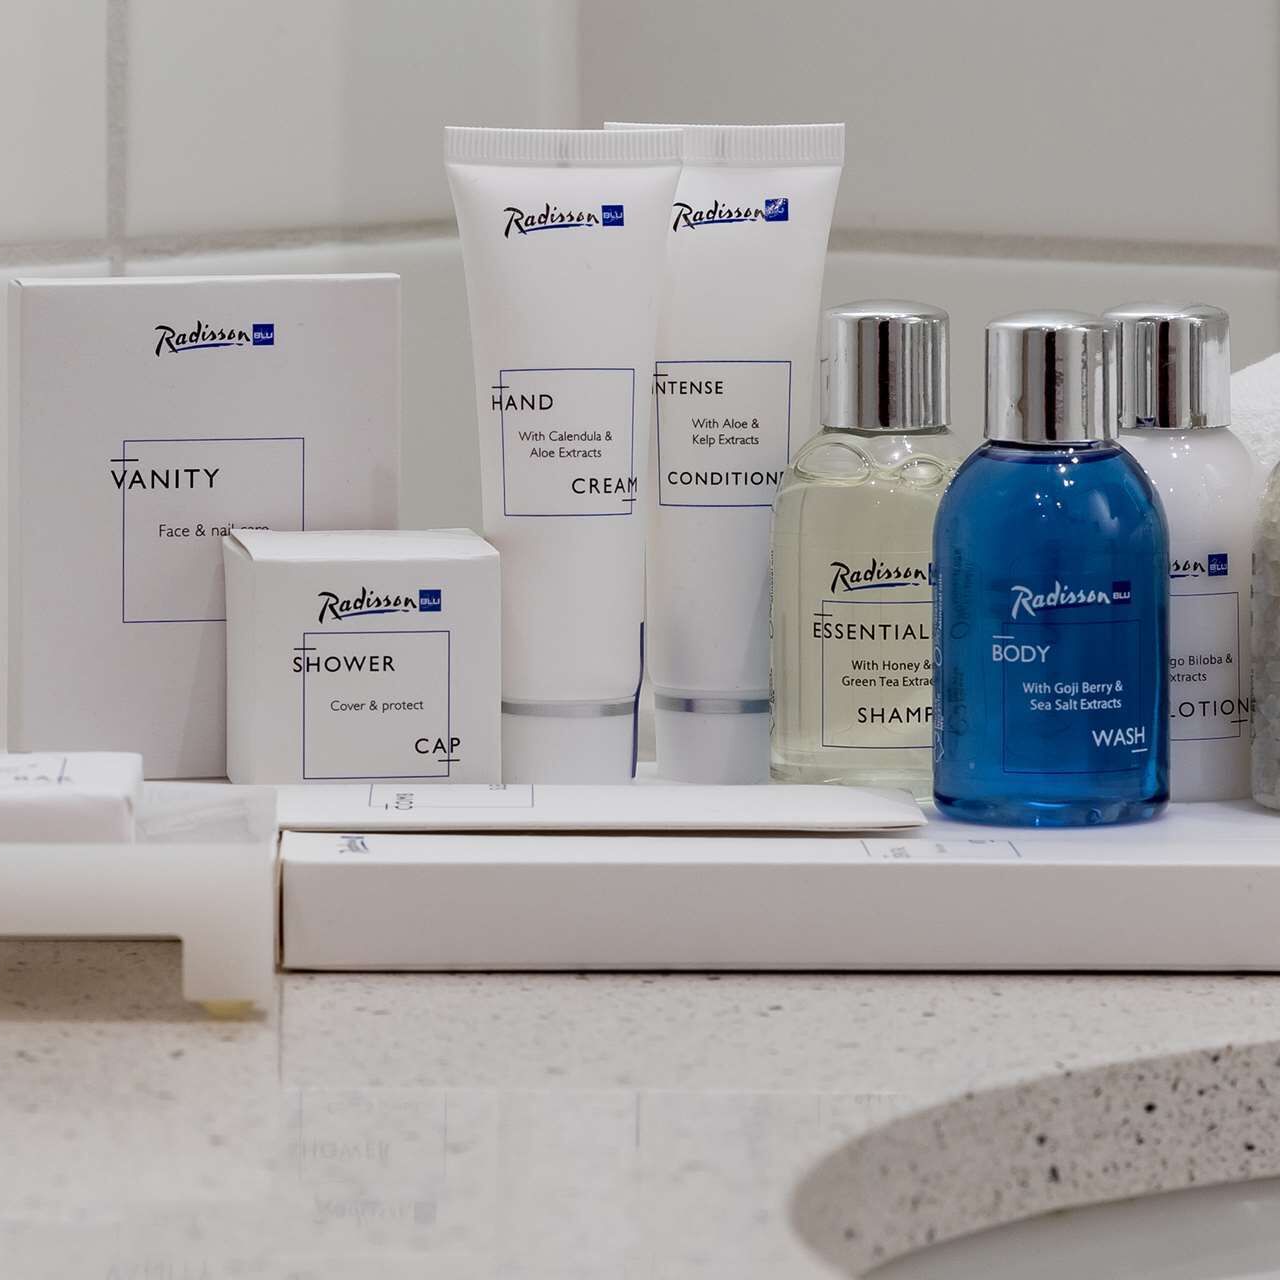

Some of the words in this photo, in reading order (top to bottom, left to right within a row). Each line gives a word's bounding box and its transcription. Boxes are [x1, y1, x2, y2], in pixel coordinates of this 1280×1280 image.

[503, 202, 600, 238] Radisson
[672, 199, 765, 232] Radisson
[154, 320, 251, 357] Radisson
[491, 394, 554, 411] HAND
[691, 418, 719, 430] With
[722, 418, 748, 430] Aloe
[751, 418, 760, 429] &
[518, 431, 545, 442] With
[548, 430, 602, 442] Calendula
[604, 431, 613, 442] &
[692, 434, 716, 447] Kelp
[718, 434, 760, 445] Extracts
[529, 447, 555, 458] Aloe
[558, 447, 602, 458] Extracts
[110, 468, 220, 490] VANITY
[571, 476, 638, 494] CREAM
[158, 524, 190, 537] Face
[195, 523, 207, 538] &
[830, 558, 927, 594] Radisson
[317, 586, 417, 624] Radisson
[1010, 580, 1111, 619] Radisson
[813, 622, 930, 641] ESSENTIAL
[991, 644, 1051, 663] BODY
[1188, 654, 1223, 666] Biloba
[1225, 653, 1233, 665] &
[292, 656, 396, 673] SHOWER
[851, 660, 879, 671] With
[882, 660, 920, 673] Honey
[923, 659, 931, 670] &
[841, 676, 877, 687] Green
[879, 676, 900, 687] Tea
[1170, 673, 1207, 682] xtracts
[1023, 682, 1051, 694] With
[1054, 682, 1079, 697] Goji
[1082, 681, 1113, 695] Berry
[1114, 680, 1123, 692] &
[330, 699, 366, 712] Cover
[369, 700, 378, 711] &
[382, 700, 424, 713] protect
[1030, 699, 1052, 711] Sea
[1055, 699, 1078, 711] Salt
[1080, 698, 1122, 710] Extracts
[1170, 697, 1249, 718] OTION
[1092, 726, 1146, 747] WASH
[414, 737, 461, 754] CAP
